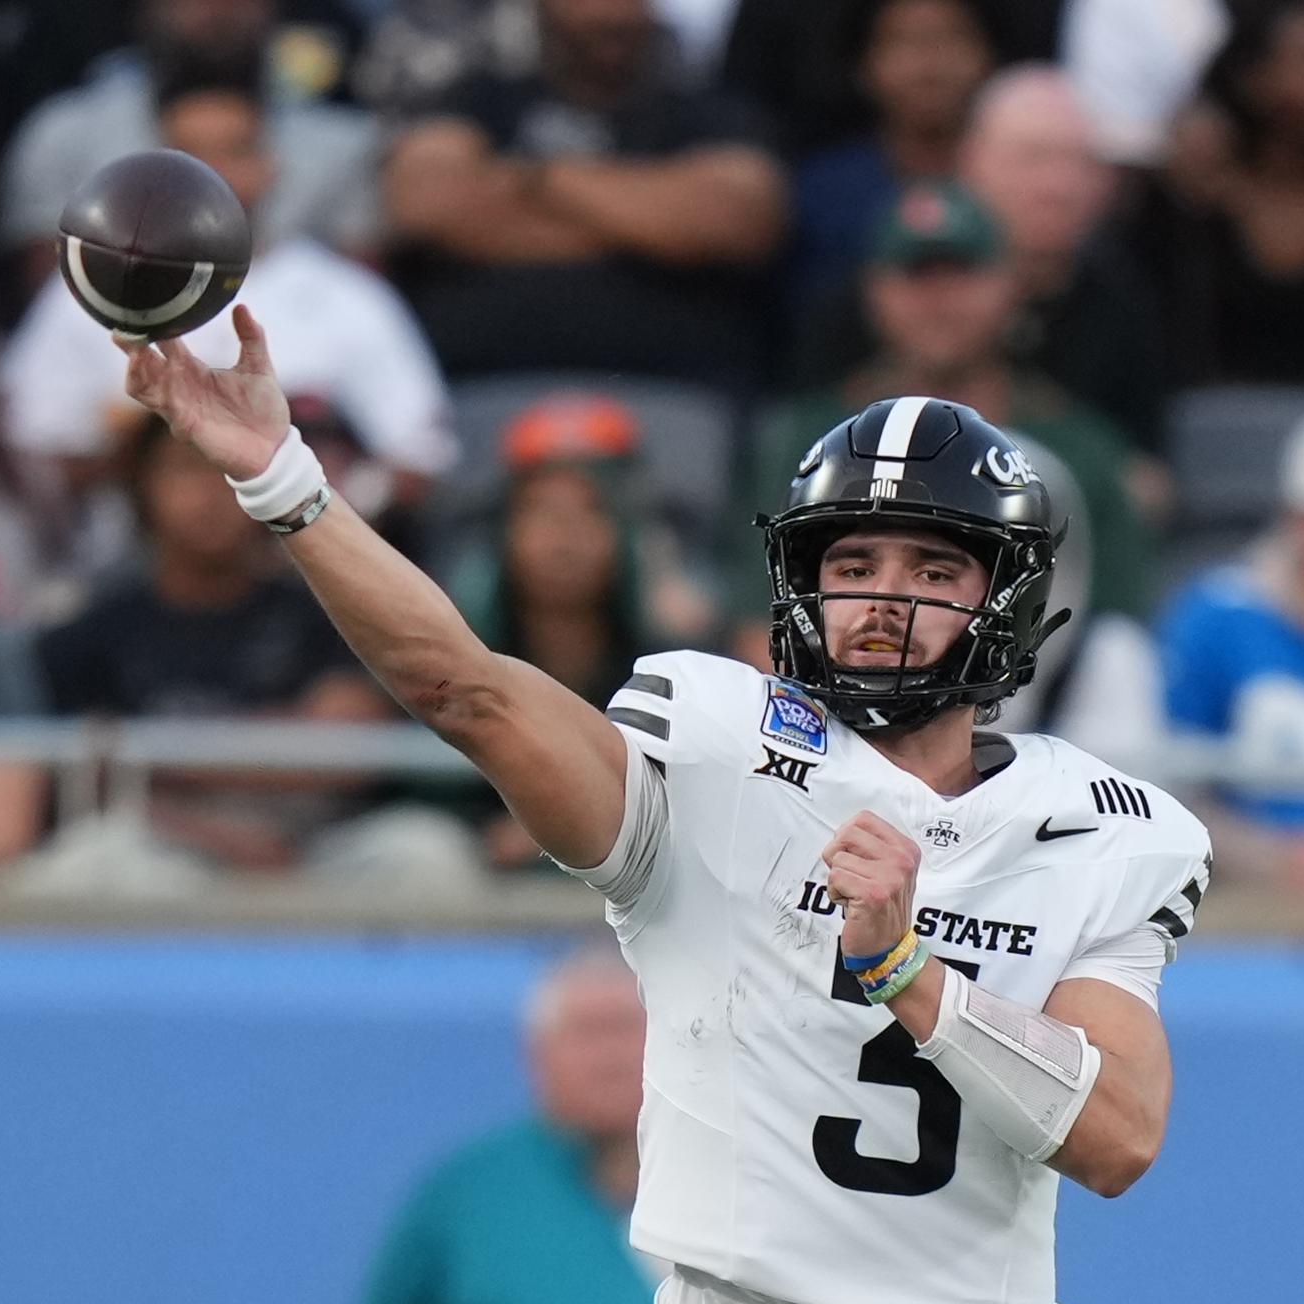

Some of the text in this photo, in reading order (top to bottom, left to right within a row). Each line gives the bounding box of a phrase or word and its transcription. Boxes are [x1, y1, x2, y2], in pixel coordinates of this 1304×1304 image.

[753, 743, 819, 793] XII
[797, 880, 847, 921] IO
[914, 906, 1037, 956] STATE
[812, 933, 982, 1196] 3
